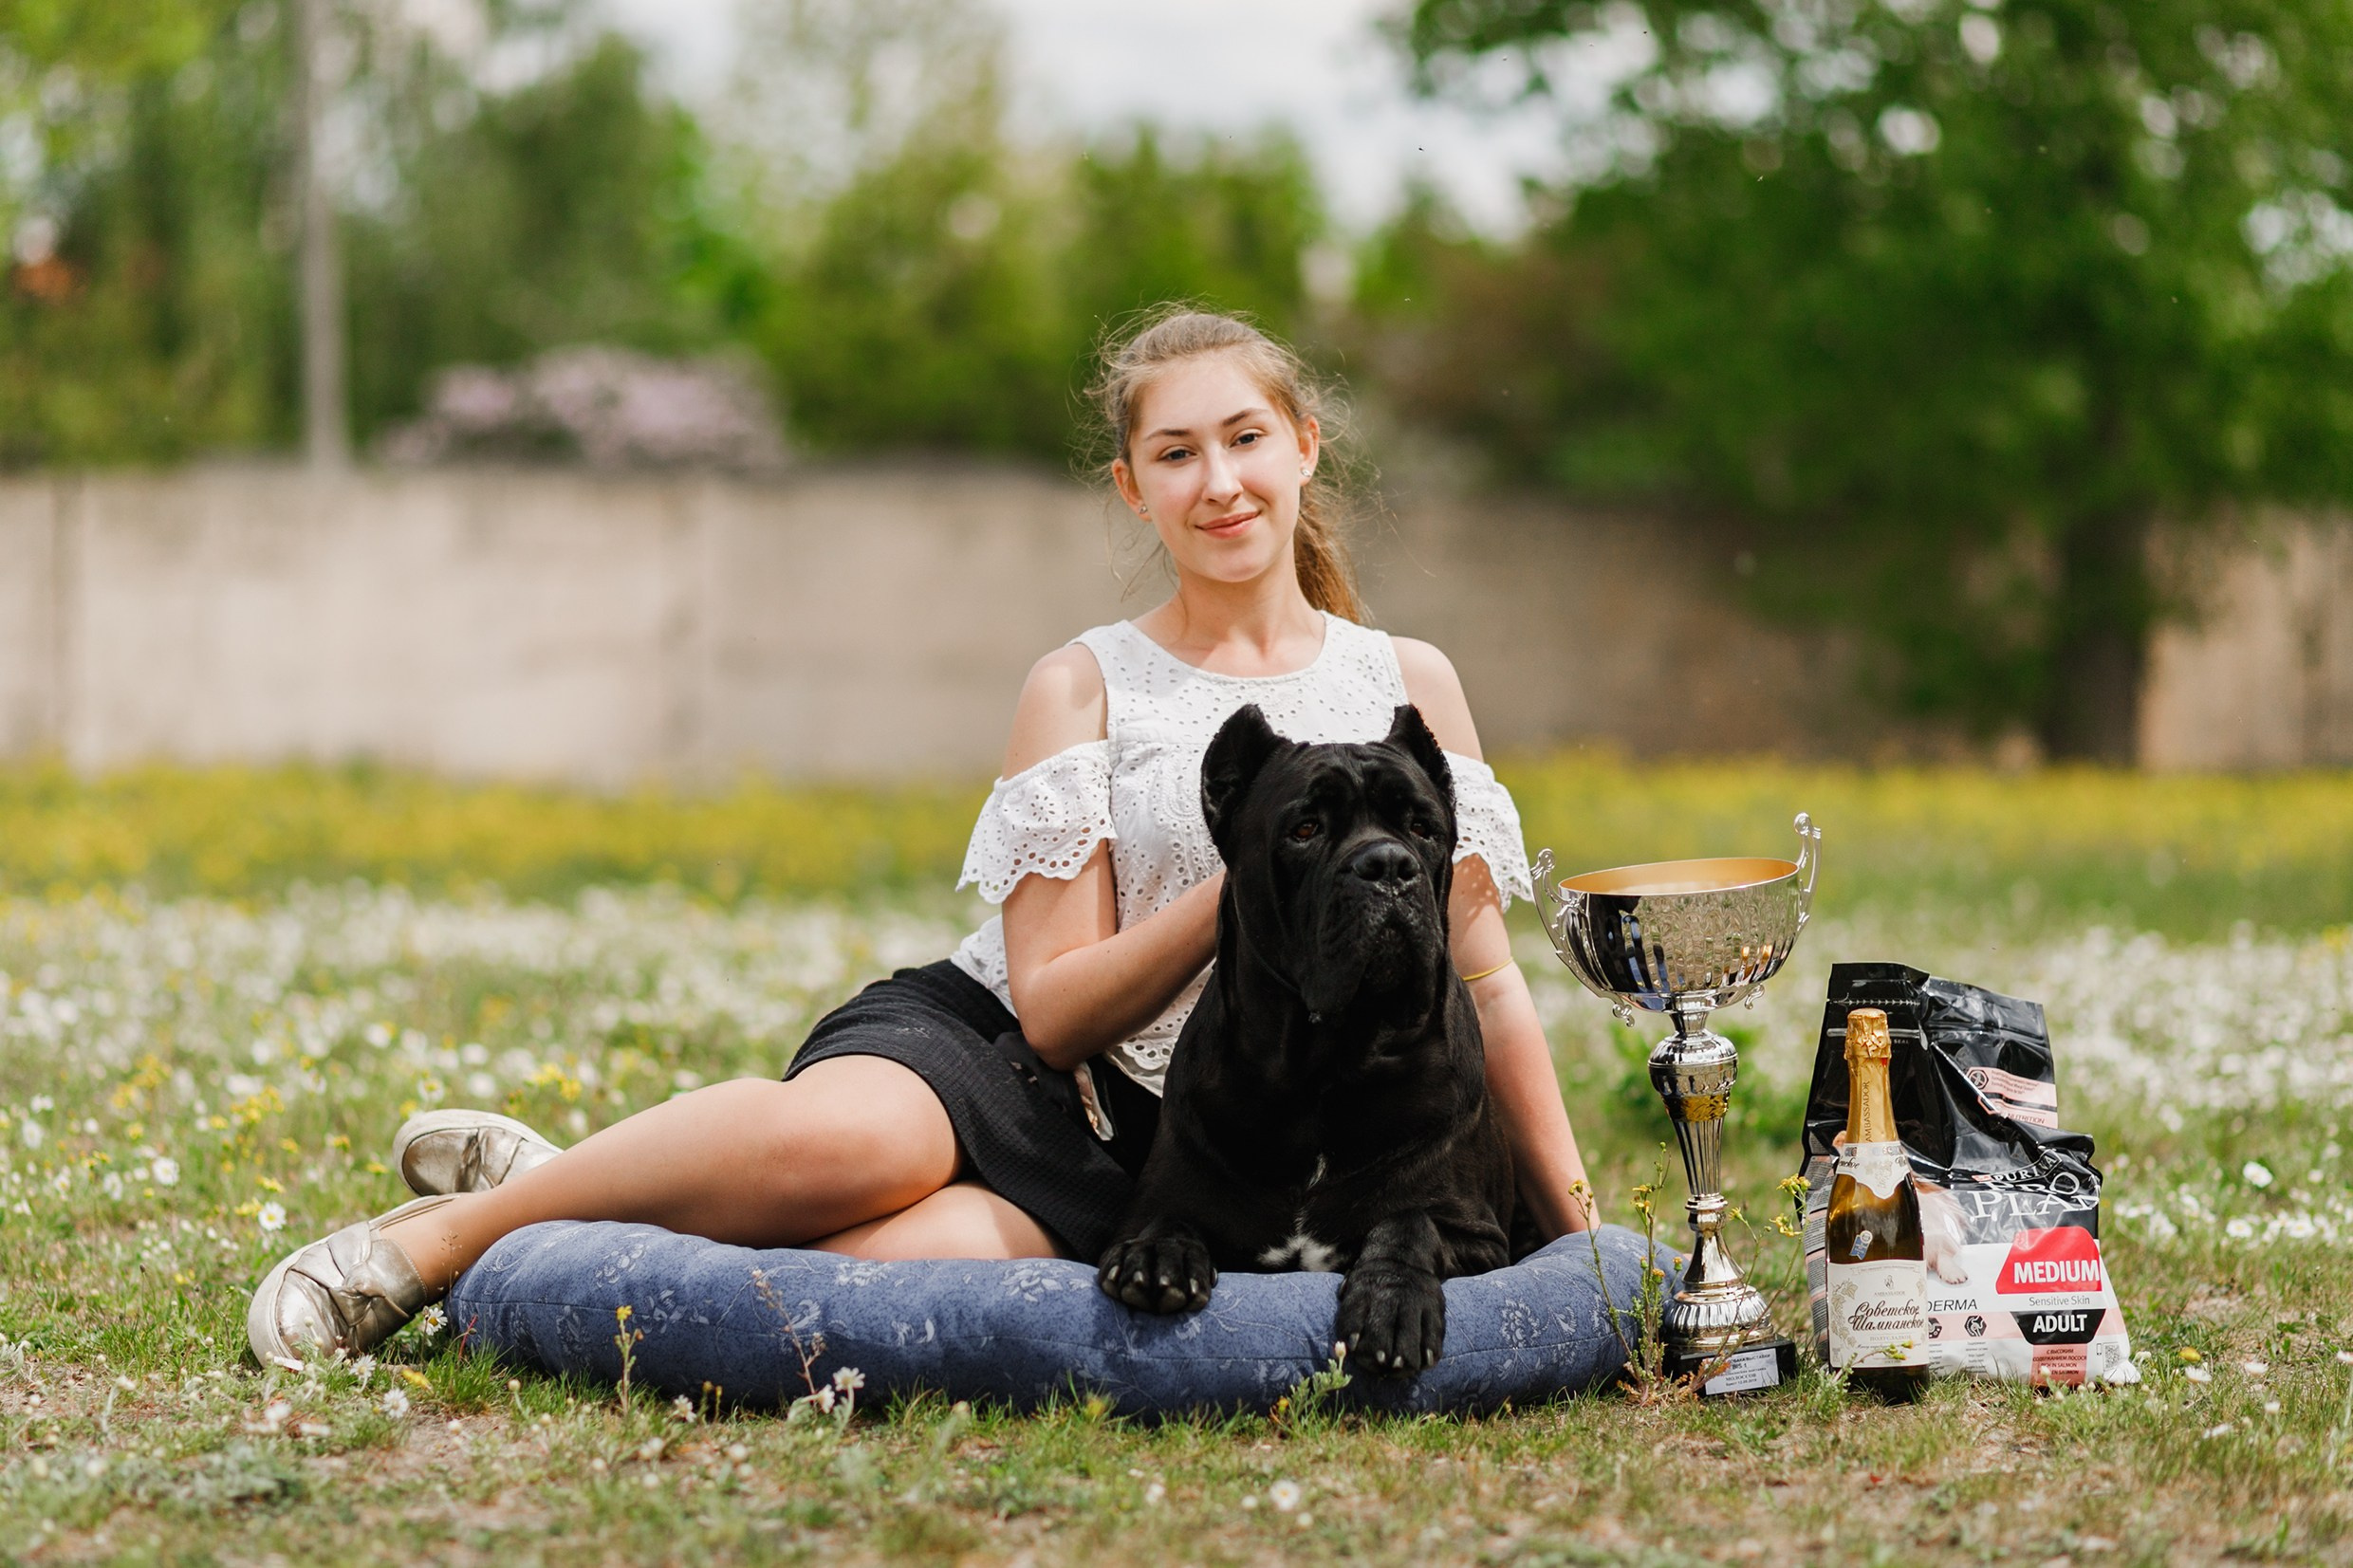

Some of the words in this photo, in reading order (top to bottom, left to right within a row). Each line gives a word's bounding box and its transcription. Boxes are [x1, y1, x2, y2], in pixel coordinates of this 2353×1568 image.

[1862, 1080, 1873, 1143] AMBASSADOR
[2014, 1260, 2100, 1283] MEDIUM
[1855, 1299, 1919, 1317] Советское
[2029, 1296, 2068, 1306] Sensitive
[2070, 1295, 2090, 1305] Skin
[1847, 1312, 1924, 1332] Шампанское
[2032, 1314, 2087, 1333] ADULT
